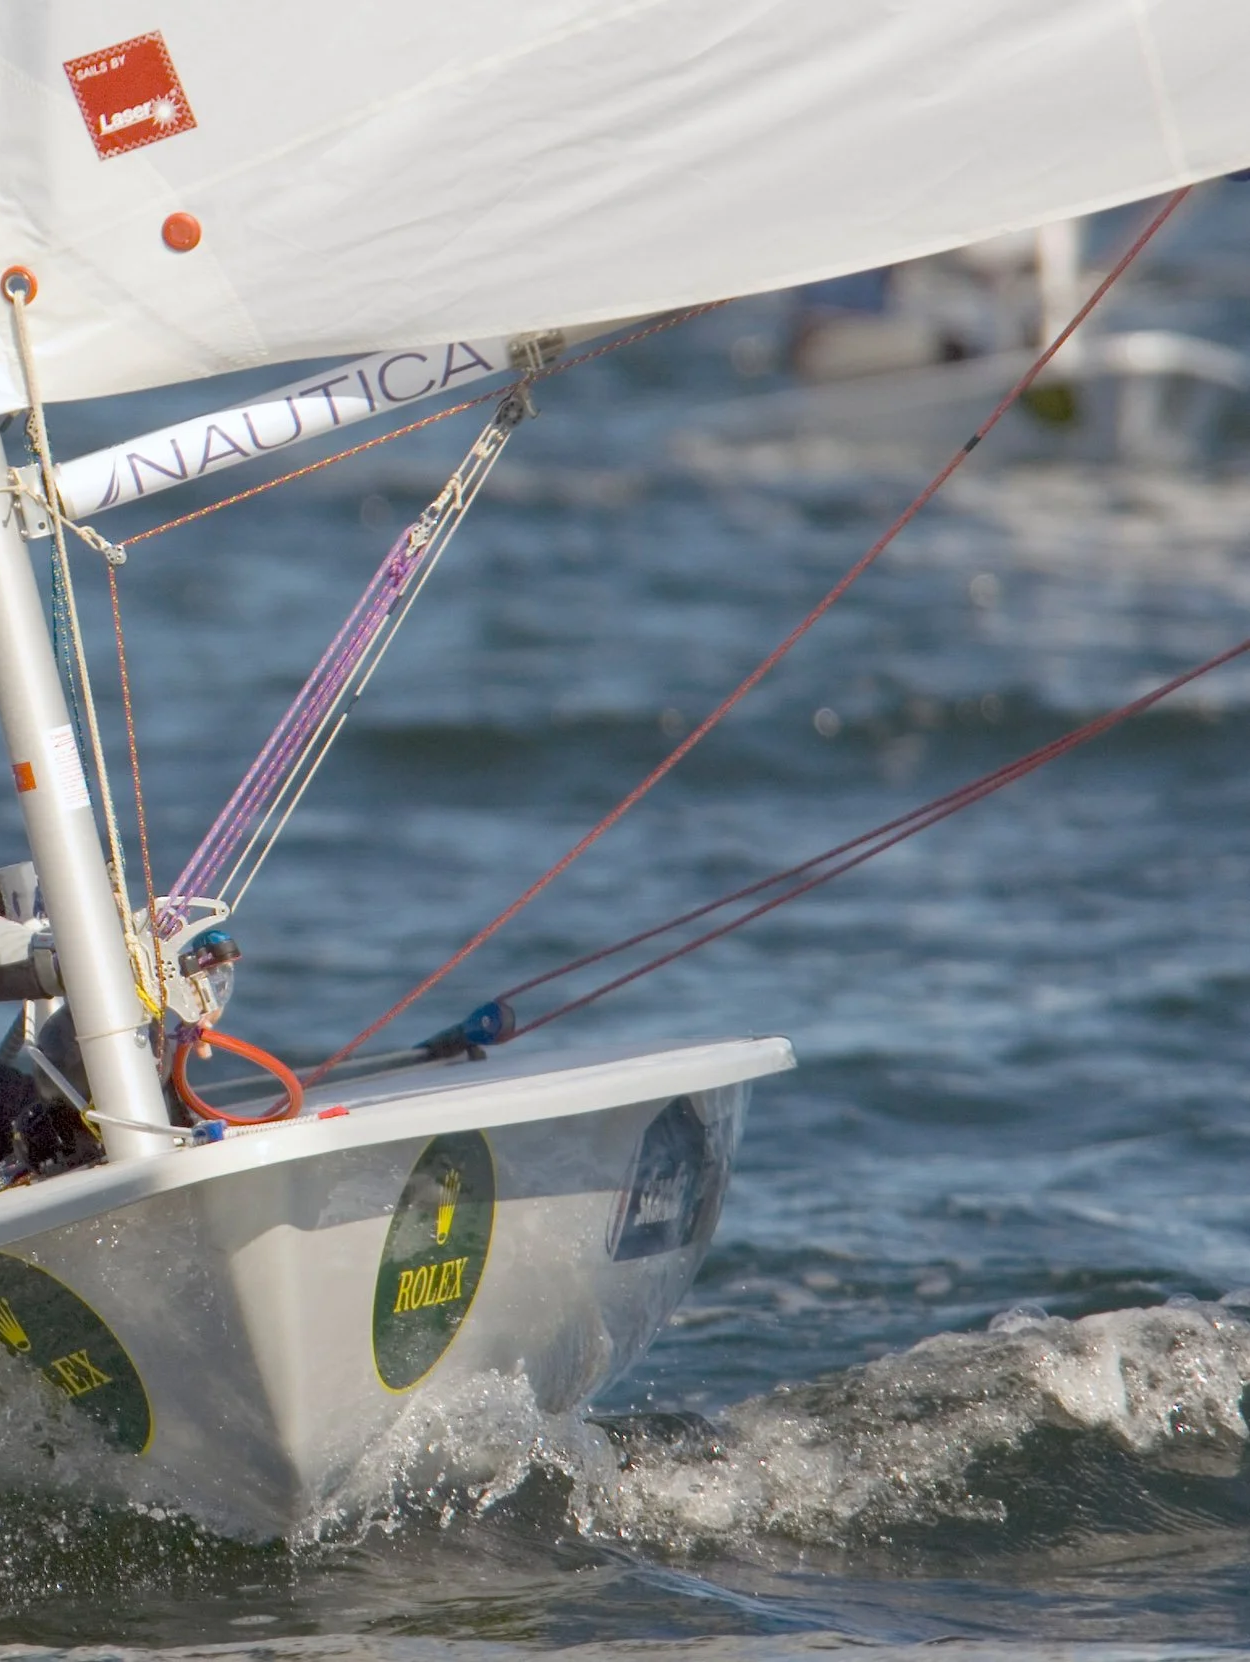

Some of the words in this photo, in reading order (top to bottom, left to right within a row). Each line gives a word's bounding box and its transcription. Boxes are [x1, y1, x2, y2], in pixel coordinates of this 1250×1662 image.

[75, 61, 108, 81] SAILS
[110, 54, 126, 70] BY
[99, 100, 152, 134] Laser
[127, 341, 494, 496] NAUTICA
[393, 1256, 469, 1314] ROLEX
